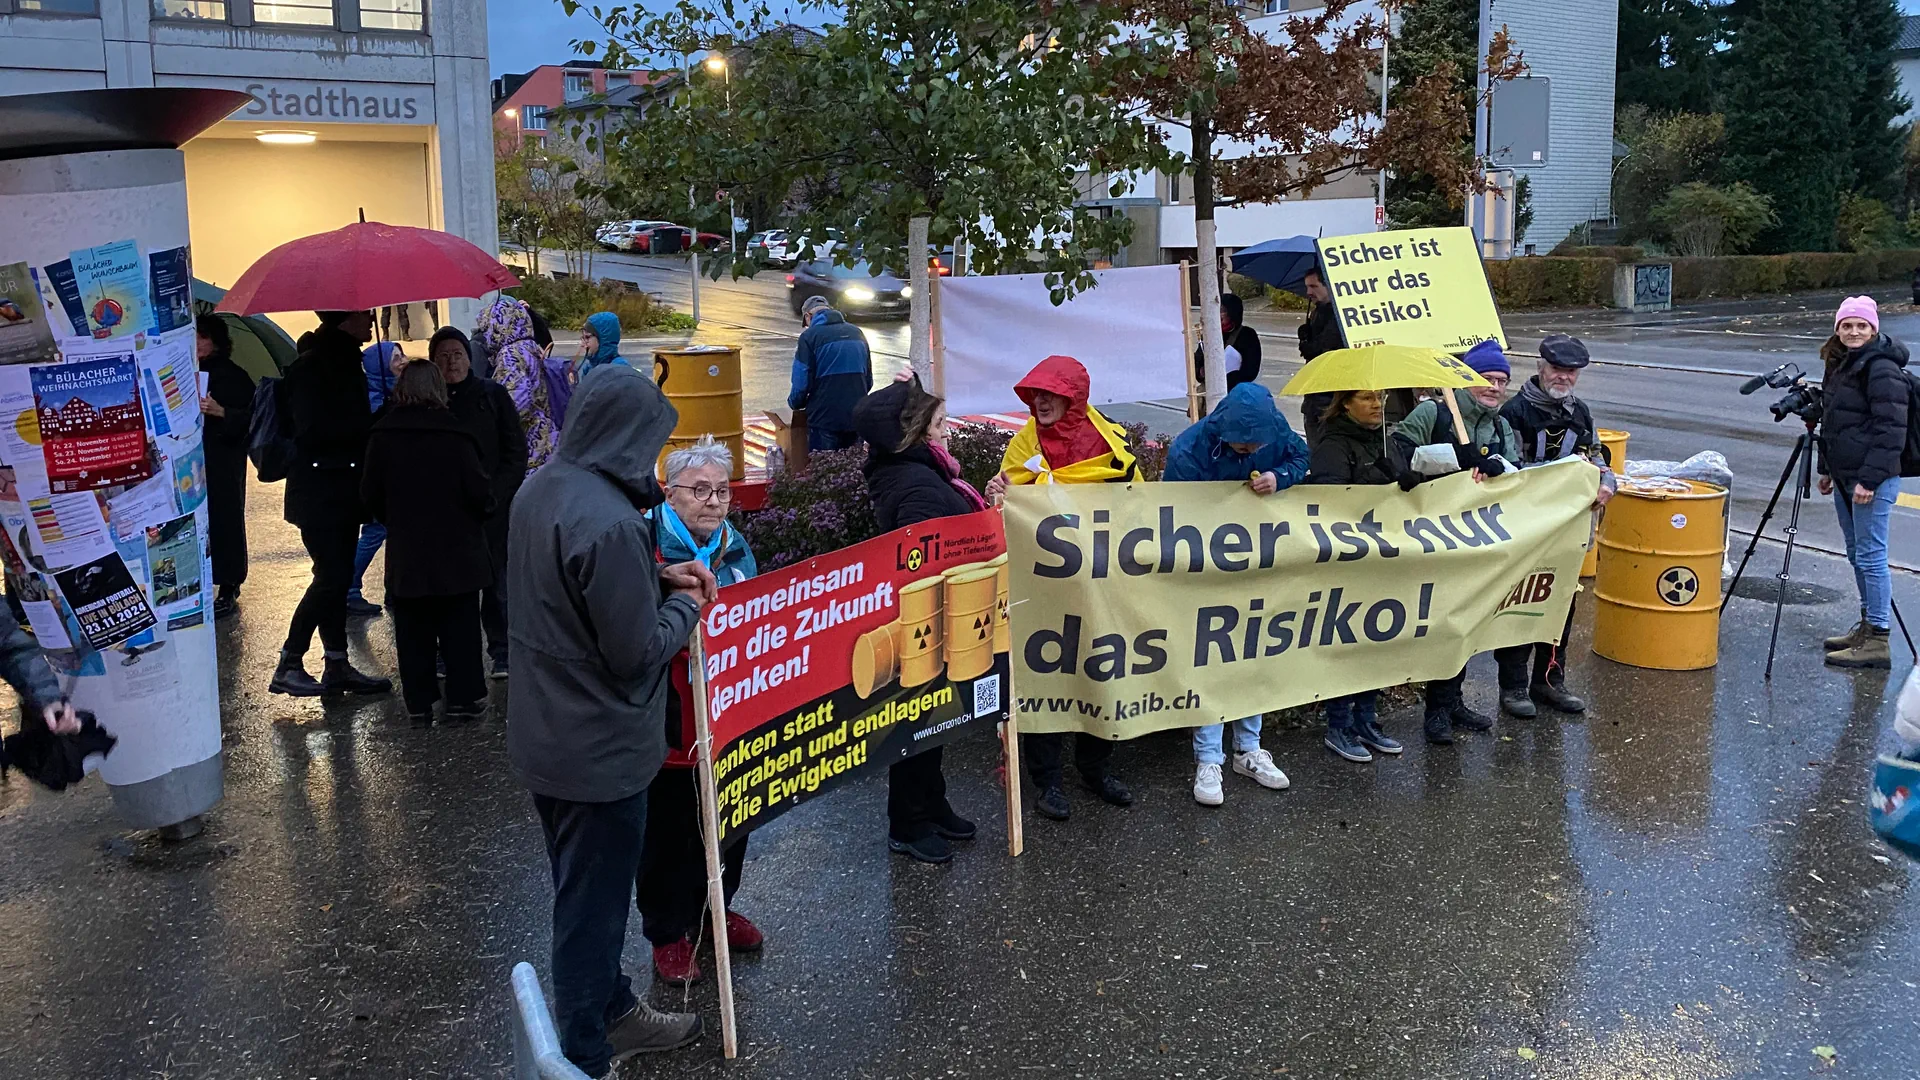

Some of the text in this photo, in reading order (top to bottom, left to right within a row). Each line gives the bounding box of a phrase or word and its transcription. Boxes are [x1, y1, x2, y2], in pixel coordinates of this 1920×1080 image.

[246, 84, 417, 119] Stadthaus
[1324, 237, 1442, 268] Sicher ist
[1334, 269, 1431, 297] nur das
[1342, 298, 1432, 328] Risiko!
[38, 373, 133, 393] WEIHNACHTSMARKT
[56, 367, 116, 383] BÜLACHER
[76, 438, 109, 447] November
[78, 446, 110, 455] November
[79, 453, 112, 462] November
[1033, 502, 1513, 579] Sicher ist nur
[75, 586, 136, 615] AMERICAN FOOTBALL
[80, 611, 99, 625] LIVE
[97, 608, 109, 619] IN
[107, 593, 141, 615] BÜLACH
[707, 561, 864, 638] Gemeinsam
[85, 601, 146, 635] 23.11.2024
[708, 580, 893, 681] an die Zukunft
[1024, 582, 1434, 682] das Risiko!
[711, 645, 810, 721] denken!
[783, 700, 833, 741] statt
[1019, 689, 1201, 721] www.kaib.ch
[718, 686, 952, 812] ergraben und endlagern
[731, 740, 867, 828] die Ewigkeit!
